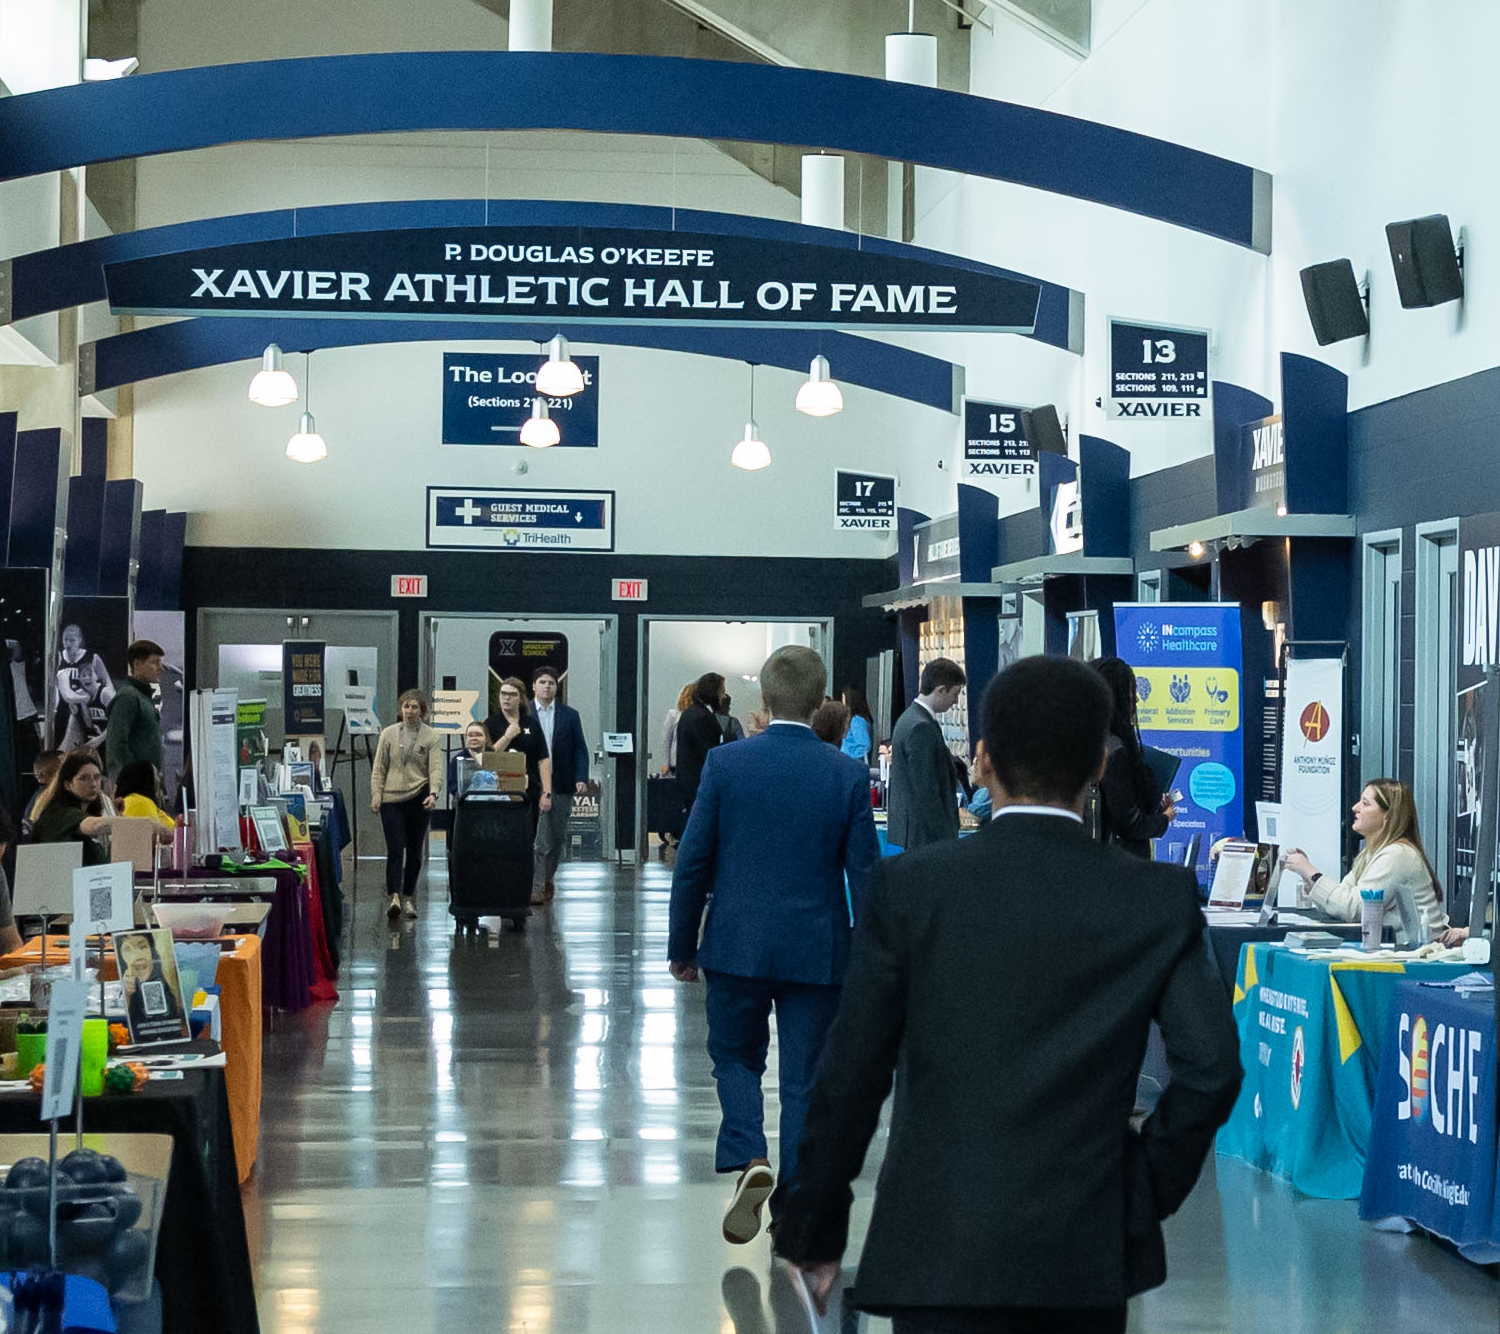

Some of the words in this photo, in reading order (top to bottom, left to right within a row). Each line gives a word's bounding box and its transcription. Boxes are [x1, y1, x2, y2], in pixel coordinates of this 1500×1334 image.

[444, 244, 462, 261] P.
[471, 244, 594, 264] DOUGLAS
[601, 247, 714, 267] O'KEEFE
[191, 268, 371, 300] XAVIER
[384, 273, 609, 308] ATHLETIC
[624, 278, 744, 311] HALL
[757, 280, 817, 312] OF
[831, 284, 958, 315] FAME
[1142, 339, 1176, 364] 13
[449, 366, 492, 383] The
[1115, 372, 1156, 381] SECTIONS
[1161, 373, 1178, 382] 211,
[1115, 384, 1156, 392] SECTIONS
[1182, 384, 1195, 392] 111
[468, 396, 520, 408] (Sections
[1117, 402, 1200, 417] XAVIER
[989, 413, 1016, 434] 15
[967, 439, 1000, 447] SECTIONS
[969, 463, 1035, 474] XAVIER
[855, 481, 875, 497] 17
[490, 504, 523, 513] GUEST
[525, 504, 569, 513] MEDICAL
[490, 514, 537, 523] SERVICES
[840, 518, 891, 528] XAVIER
[522, 532, 571, 544] TriHealth
[398, 578, 422, 595] EXIT
[619, 582, 642, 598] EXIT
[1161, 624, 1218, 638] INcompass
[1161, 639, 1218, 651] Healthcare
